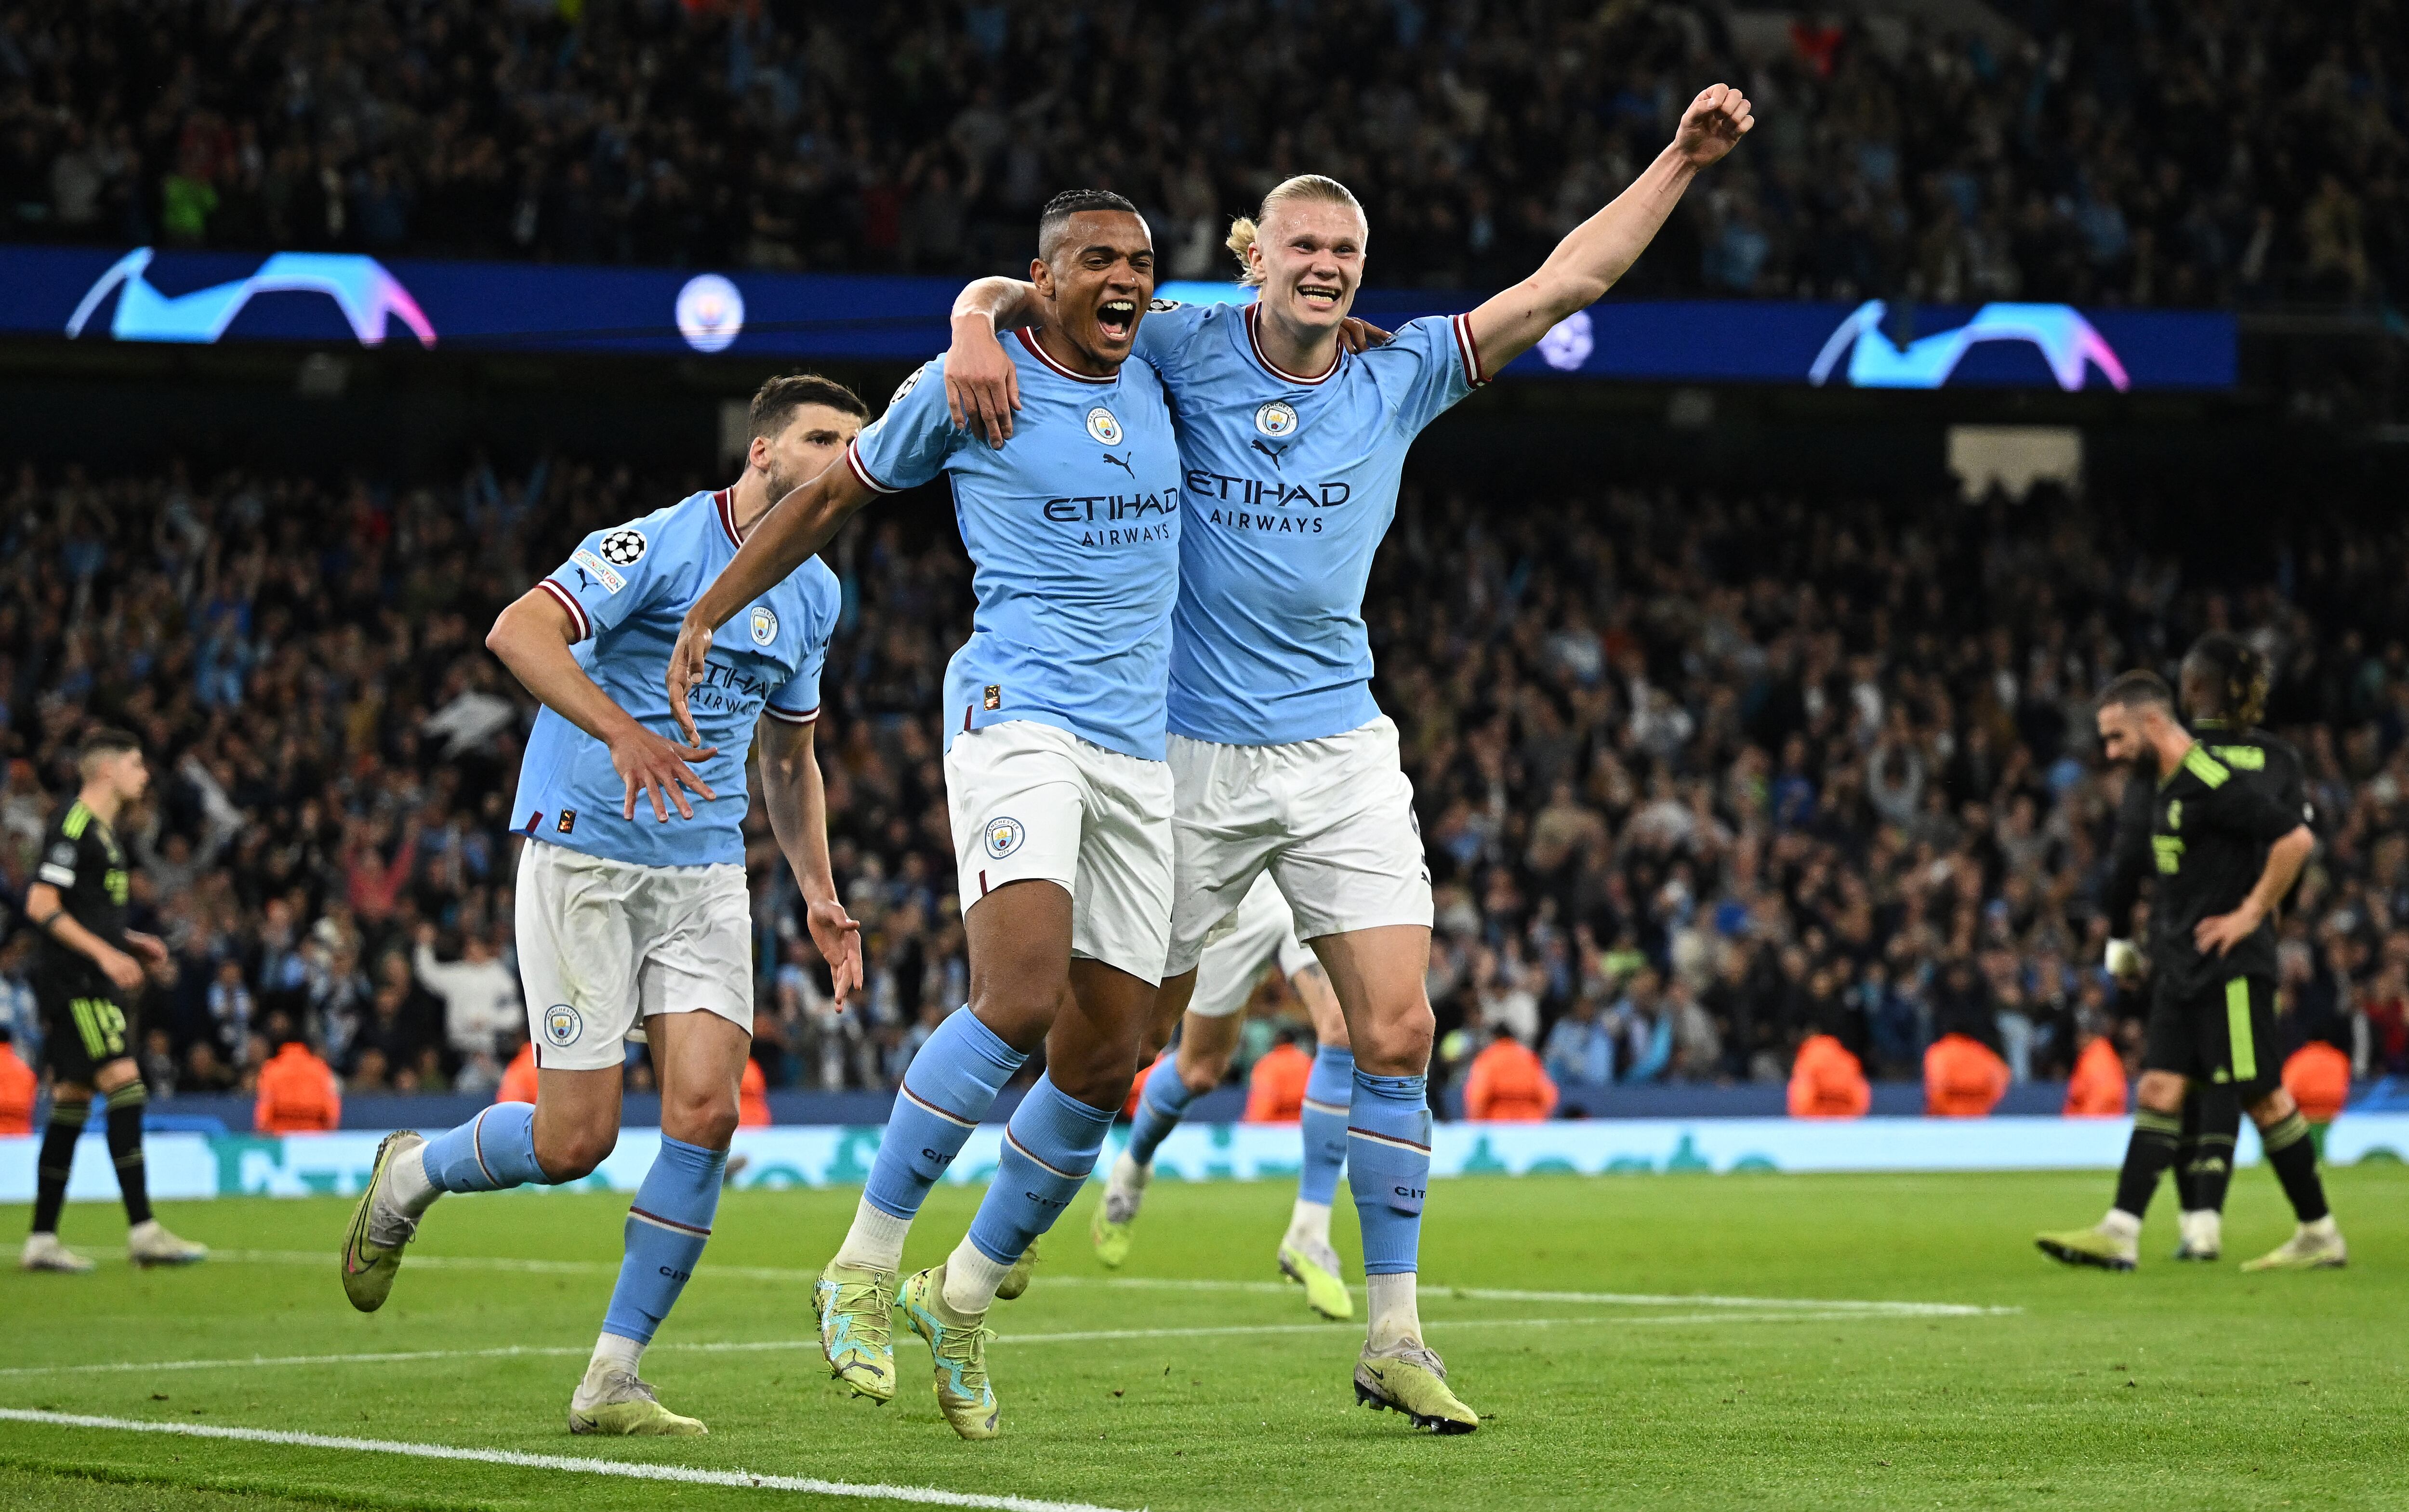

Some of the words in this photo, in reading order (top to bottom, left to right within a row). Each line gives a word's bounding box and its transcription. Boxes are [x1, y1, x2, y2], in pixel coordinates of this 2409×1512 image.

[1088, 409, 1114, 423] MANCHESTER
[1262, 402, 1295, 420] MANCHESTER
[1187, 469, 1350, 508] ETIHAD
[1043, 487, 1178, 522] ETIHAD
[1209, 508, 1323, 533] AIRWAYS
[1082, 523, 1169, 547] AIRWAYS
[577, 552, 621, 589] FOUNDATION
[751, 607, 776, 624] NCHESTER
[704, 659, 766, 700] TIHA
[688, 687, 757, 715] AIRWS
[987, 819, 1019, 837] MANCHESTER
[921, 1148, 957, 1164] CIT
[1025, 1192, 1069, 1209] CIT
[1394, 1186, 1426, 1199] CIT
